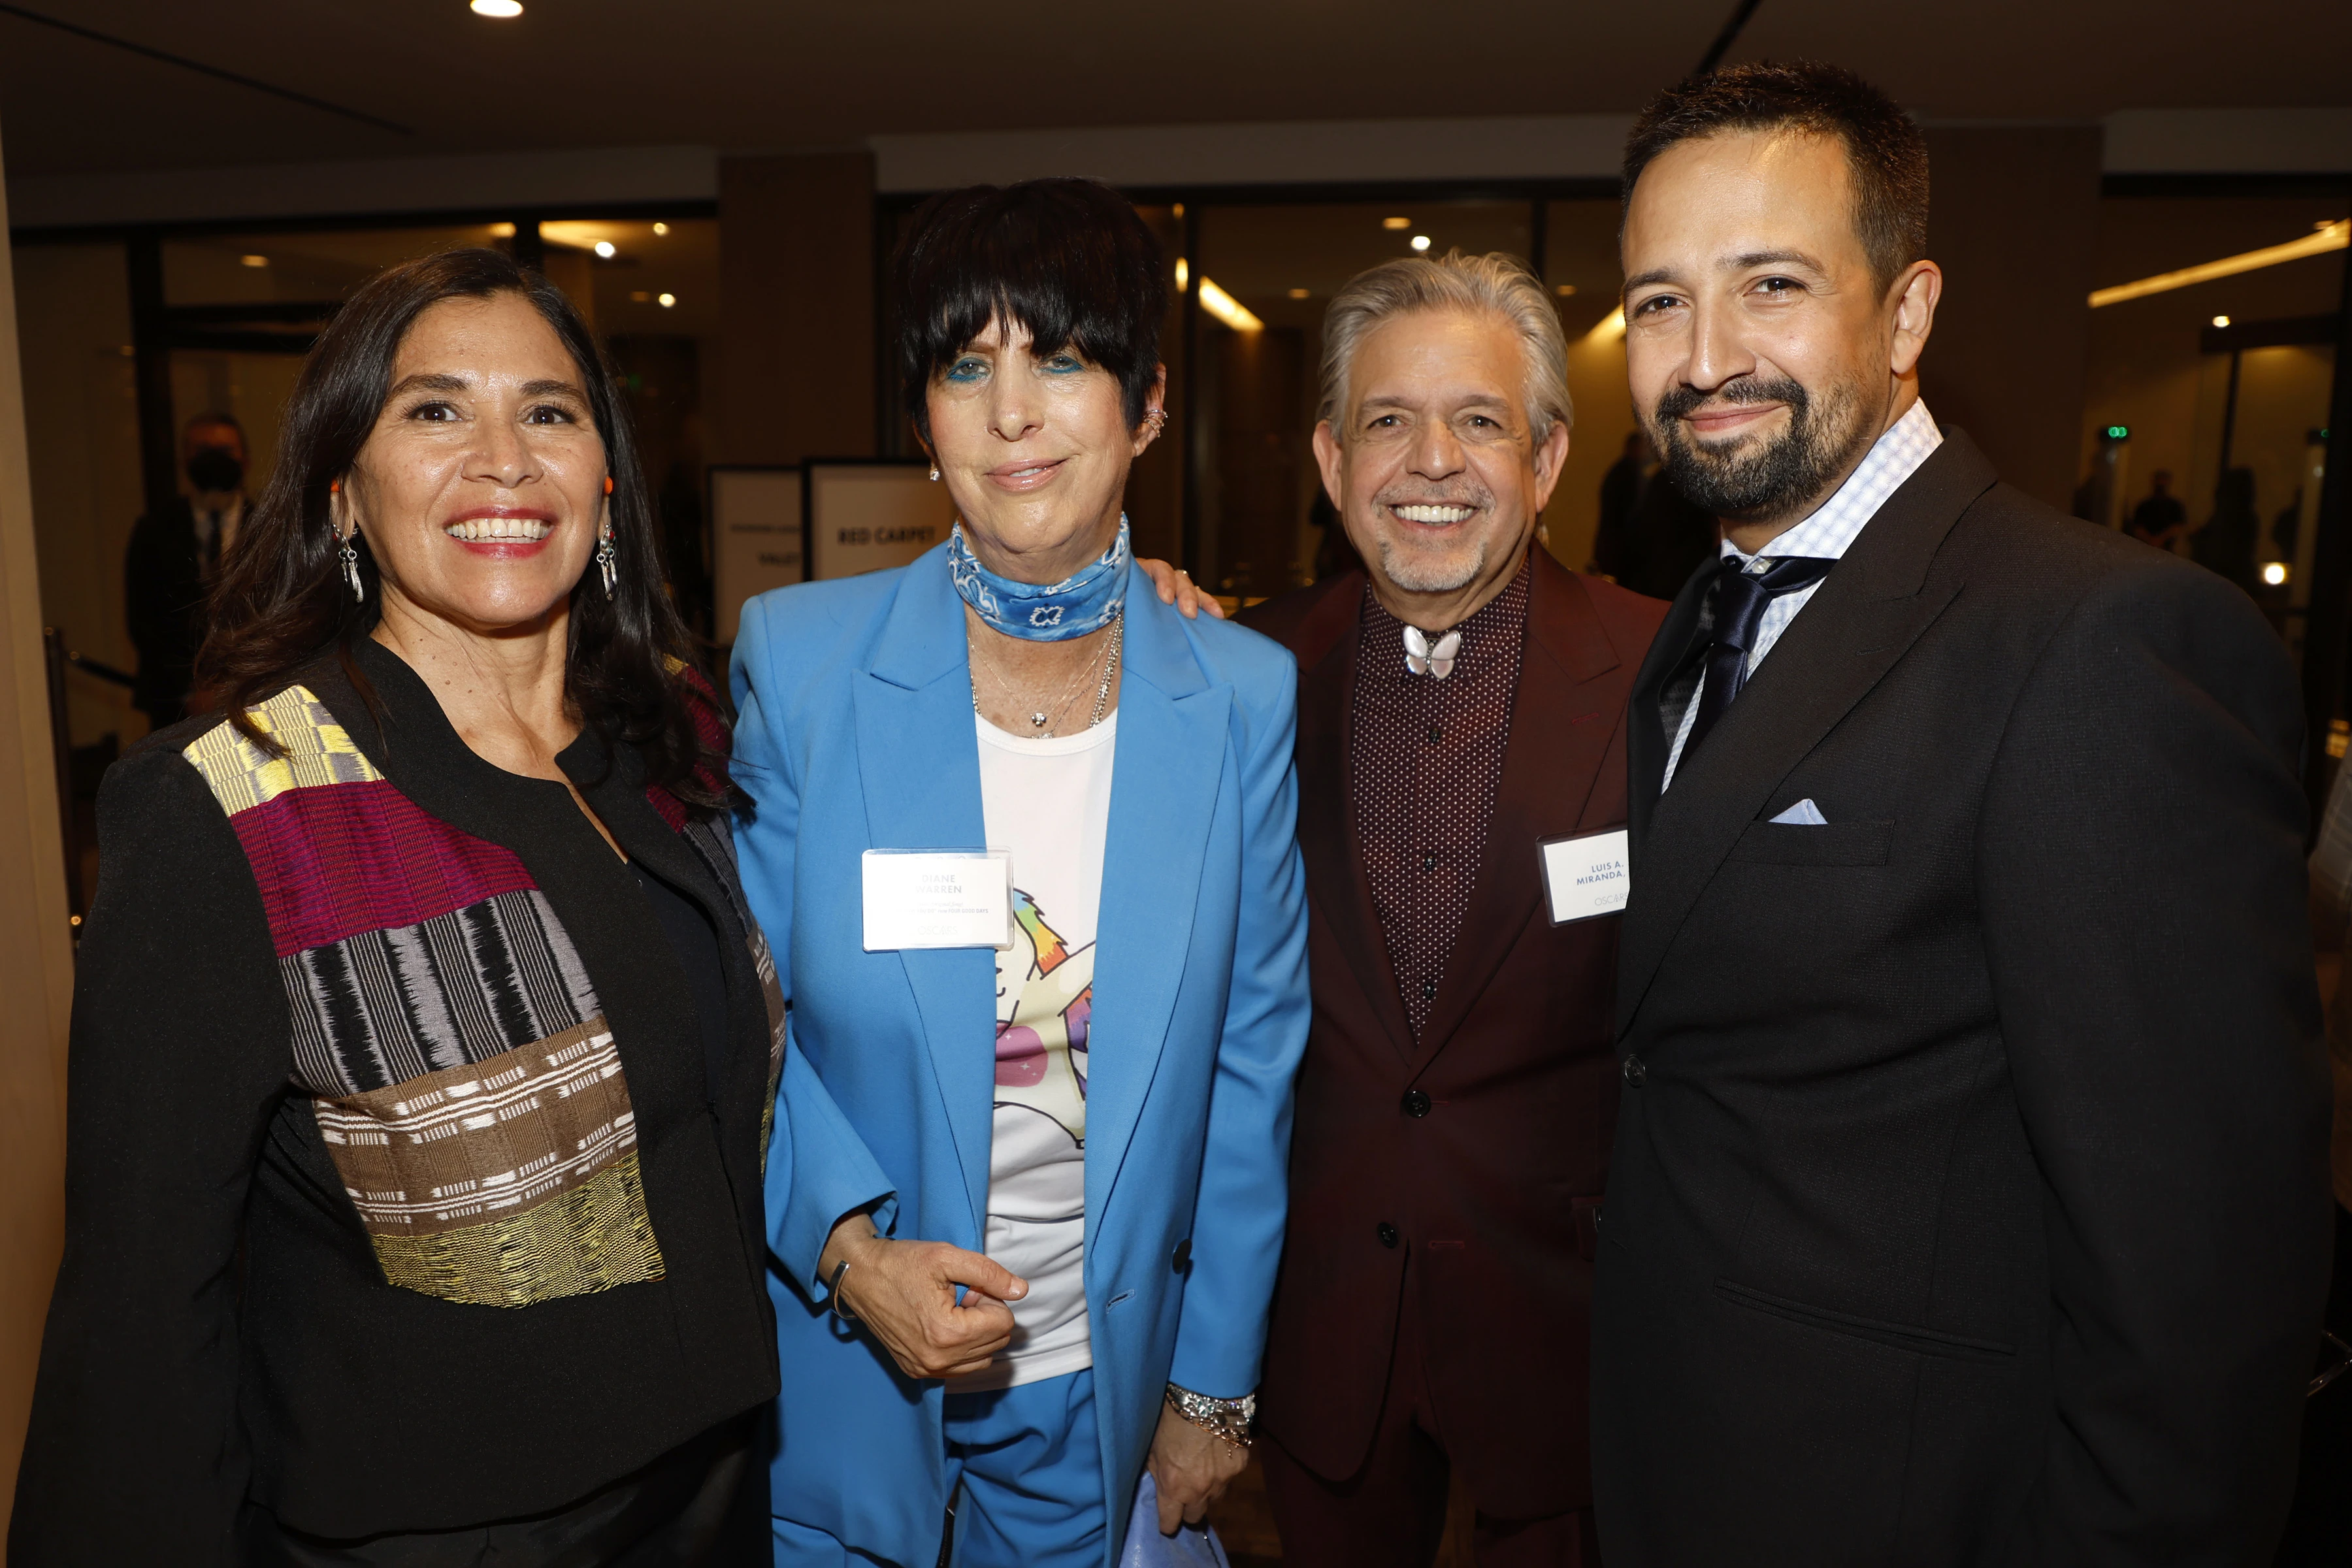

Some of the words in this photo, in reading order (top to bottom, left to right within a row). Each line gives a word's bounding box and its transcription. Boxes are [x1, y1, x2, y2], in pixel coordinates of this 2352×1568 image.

[838, 526, 871, 545] RED
[874, 525, 935, 544] CARPET
[1592, 862, 1612, 873] LUIS
[922, 874, 955, 883] DIANE
[1576, 870, 1625, 886] MIRANDA,
[916, 885, 962, 894] WARREN
[917, 925, 958, 936] OSCARS
